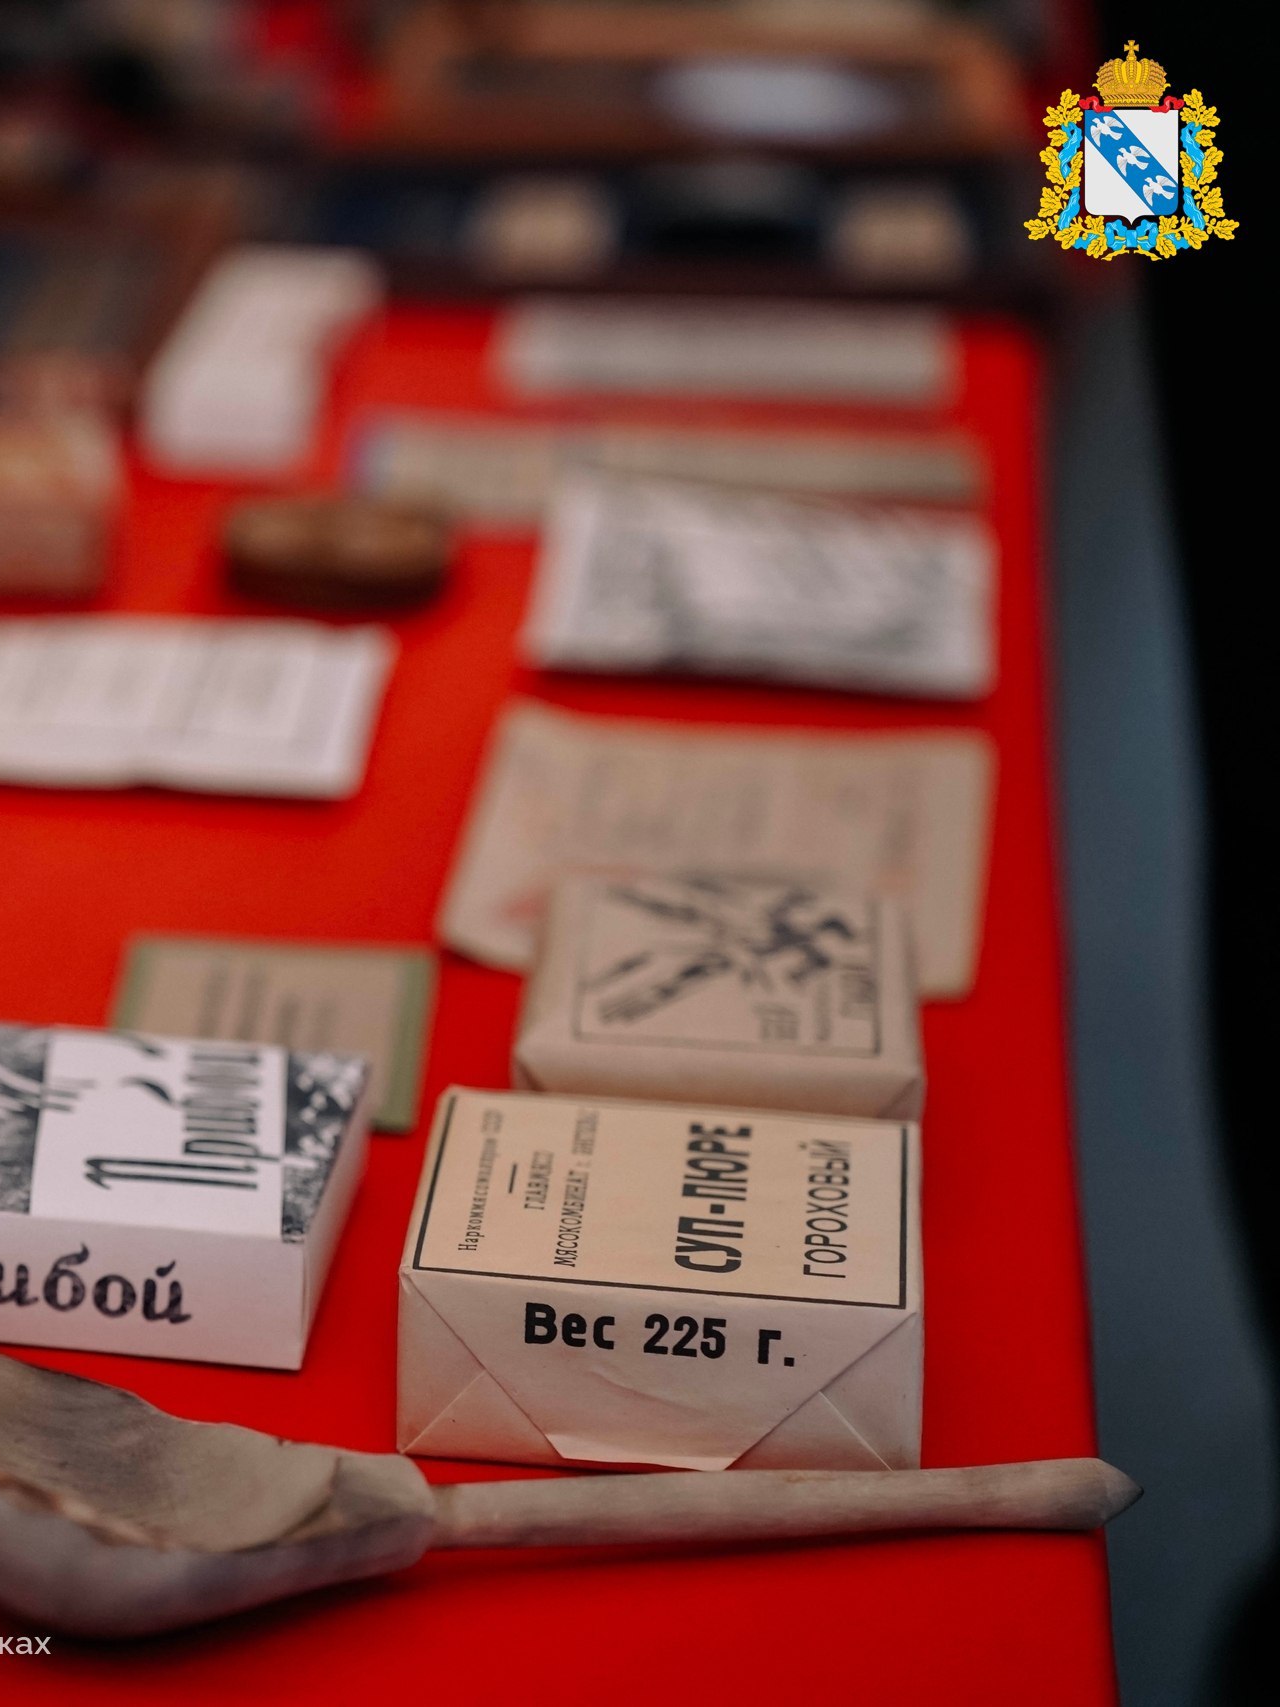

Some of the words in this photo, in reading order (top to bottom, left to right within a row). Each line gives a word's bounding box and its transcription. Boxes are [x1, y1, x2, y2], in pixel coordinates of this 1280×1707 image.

[553, 1169, 590, 1268] МЯСОКОМБИНАТ
[674, 1122, 752, 1274] СУП-ПЮРЕ
[798, 1139, 851, 1279] ГОРОХОВЫЙ
[523, 1301, 616, 1350] Вес
[642, 1312, 727, 1360] 225
[756, 1328, 795, 1368] г.
